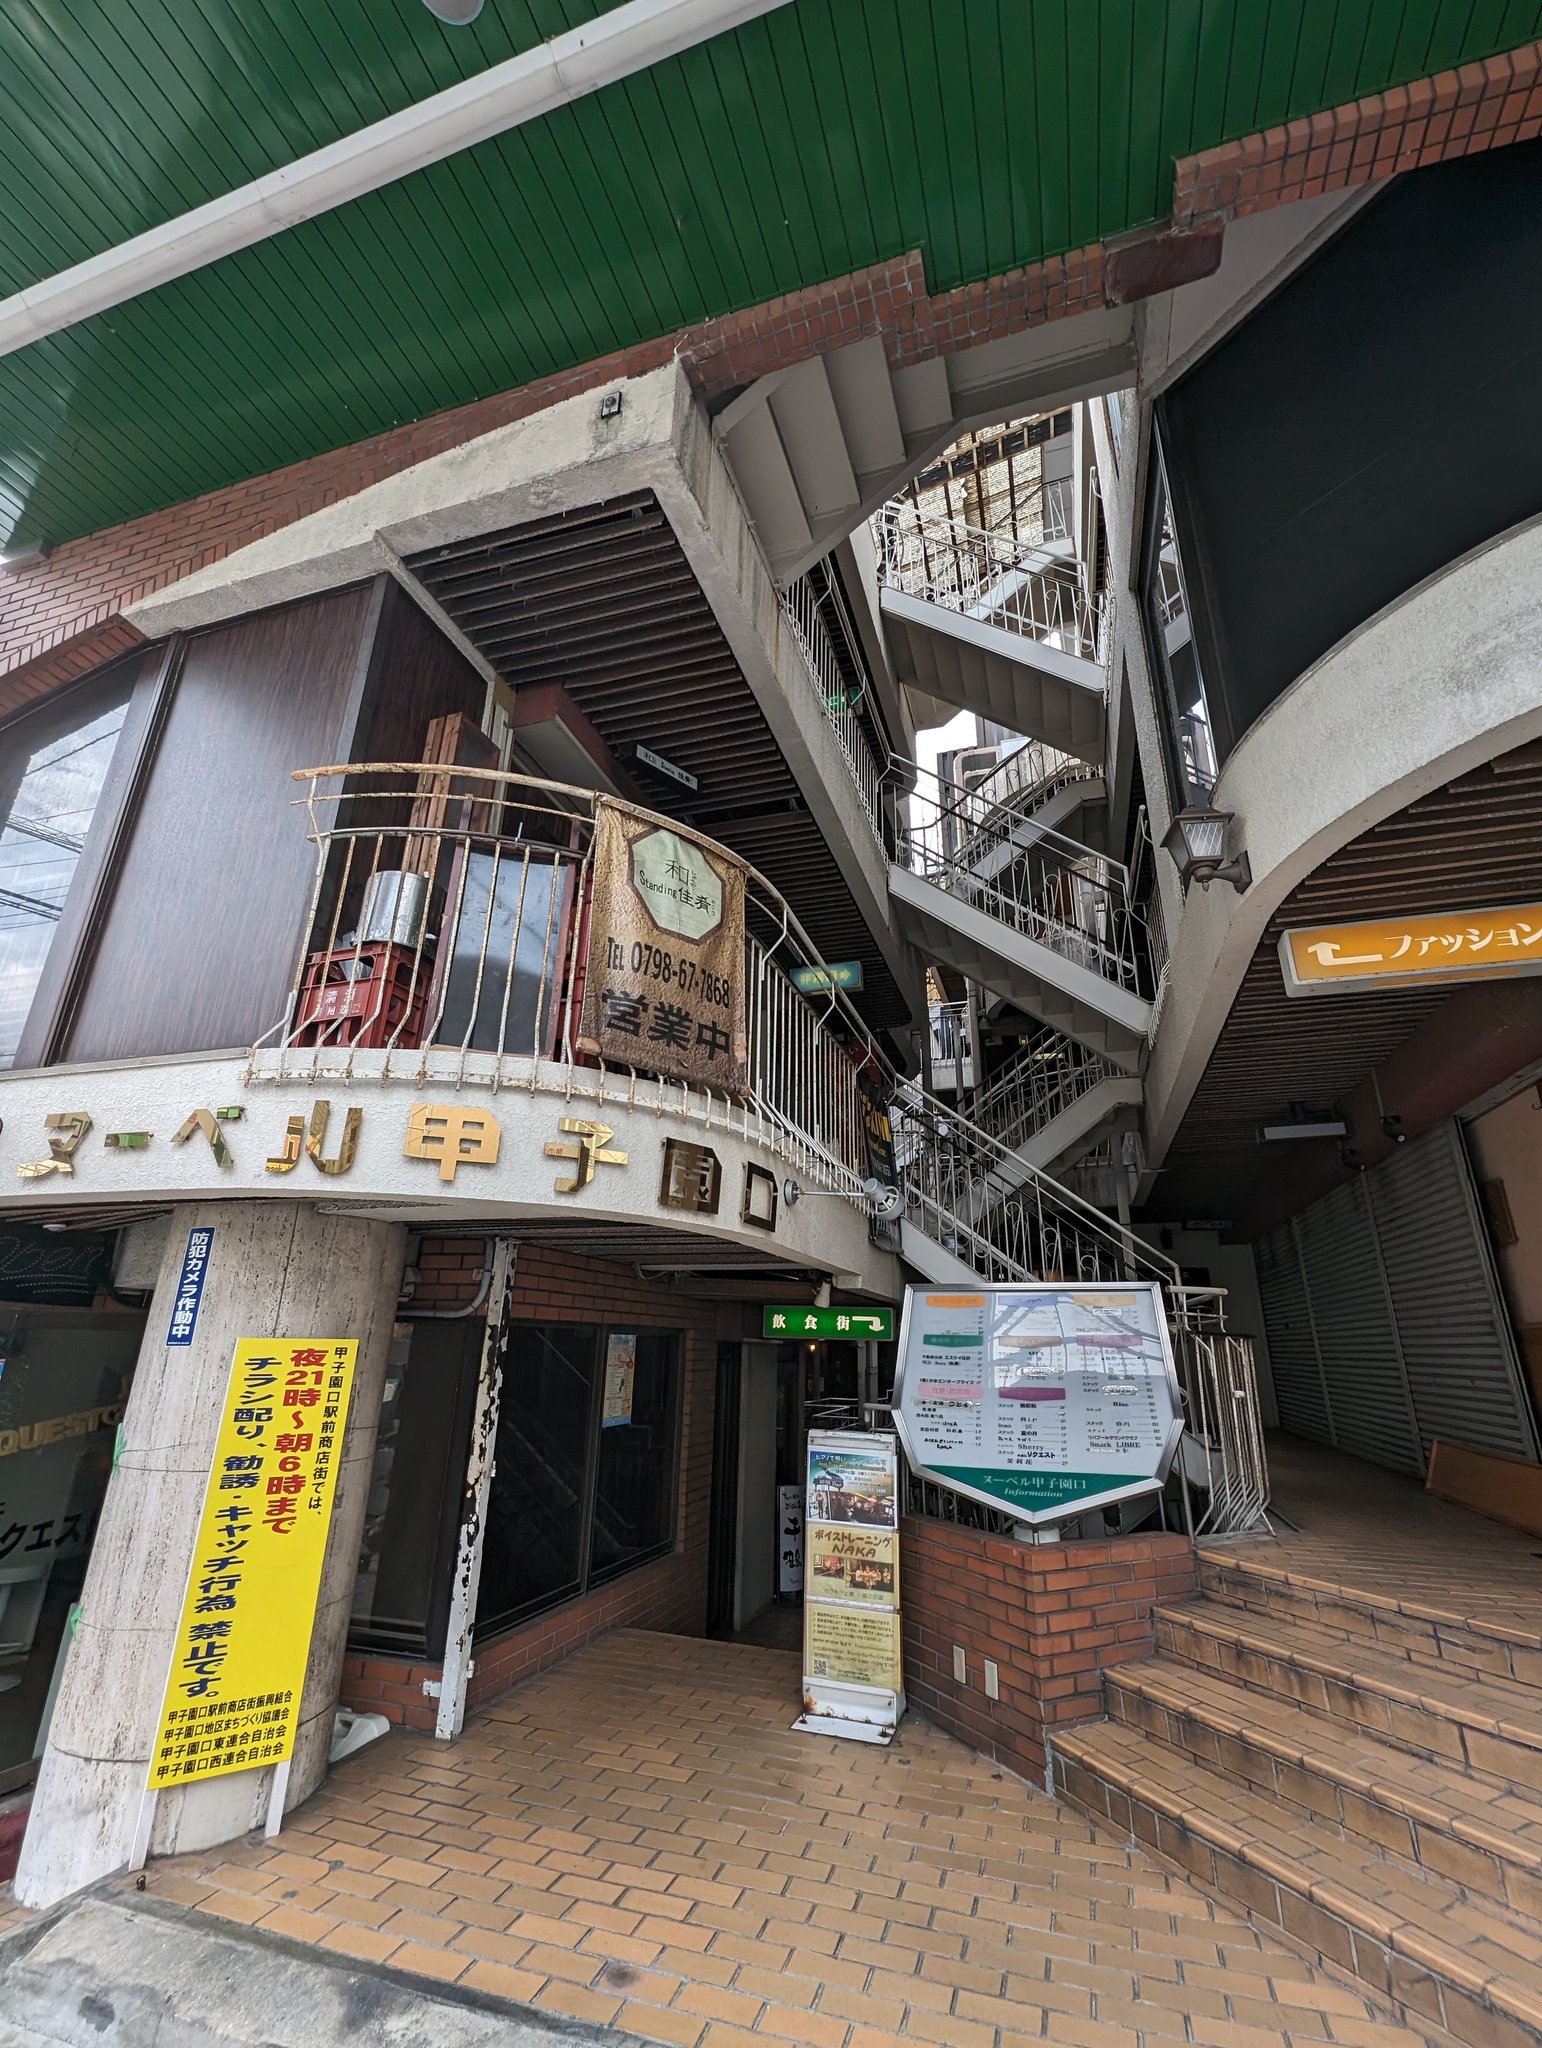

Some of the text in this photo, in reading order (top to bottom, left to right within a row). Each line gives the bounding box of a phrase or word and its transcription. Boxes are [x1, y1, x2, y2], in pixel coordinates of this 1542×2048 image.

[639, 869, 677, 899] Standing
[665, 859, 690, 886] 和
[1384, 923, 1542, 959] ファッション
[607, 936, 730, 1008] TEL 0798-67-7868
[601, 989, 731, 1060] 営業中
[171, 1232, 210, 1338] 防犯カメラ作動中
[308, 1347, 348, 1517] 甲子園口駅前商店街では、
[1018, 1443, 1044, 1452] Sherry
[984, 1475, 1086, 1489] ヌーベル甲子園口
[1004, 1488, 1063, 1498] Information
[814, 1529, 892, 1547] ボイストレーニング
[832, 1544, 876, 1557] NAKA
[168, 1690, 293, 1724] 甲子園口駅前商店街振興組合
[160, 1724, 287, 1761] 甲子園口東連合自治会
[164, 1707, 290, 1743] 甲子園口地区まちづくり協議会
[157, 1742, 284, 1779] 甲子園口西連合自治会
